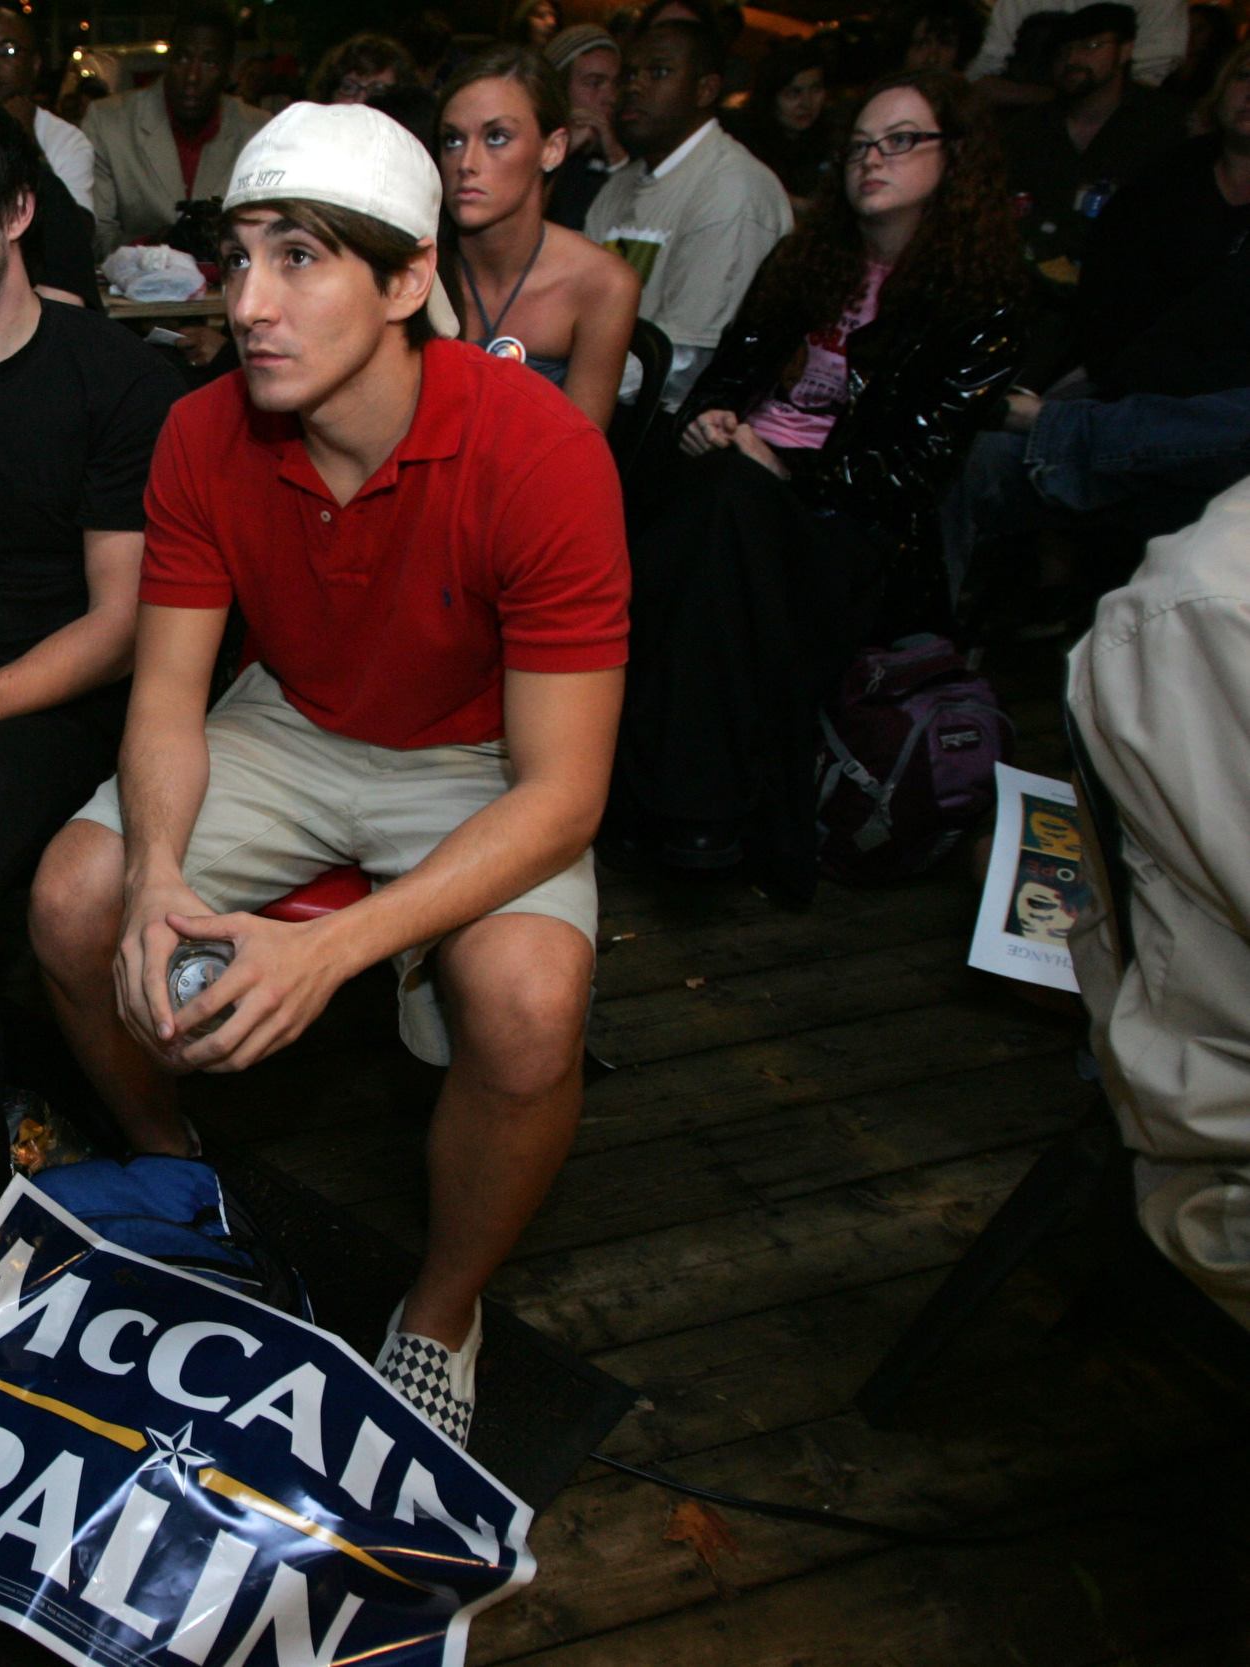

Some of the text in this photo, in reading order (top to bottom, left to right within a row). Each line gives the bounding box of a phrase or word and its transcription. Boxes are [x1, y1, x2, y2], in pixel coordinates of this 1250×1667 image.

[255, 170, 286, 187] 1977
[1025, 859, 1084, 884] OPE
[1006, 944, 1073, 969] HANGE
